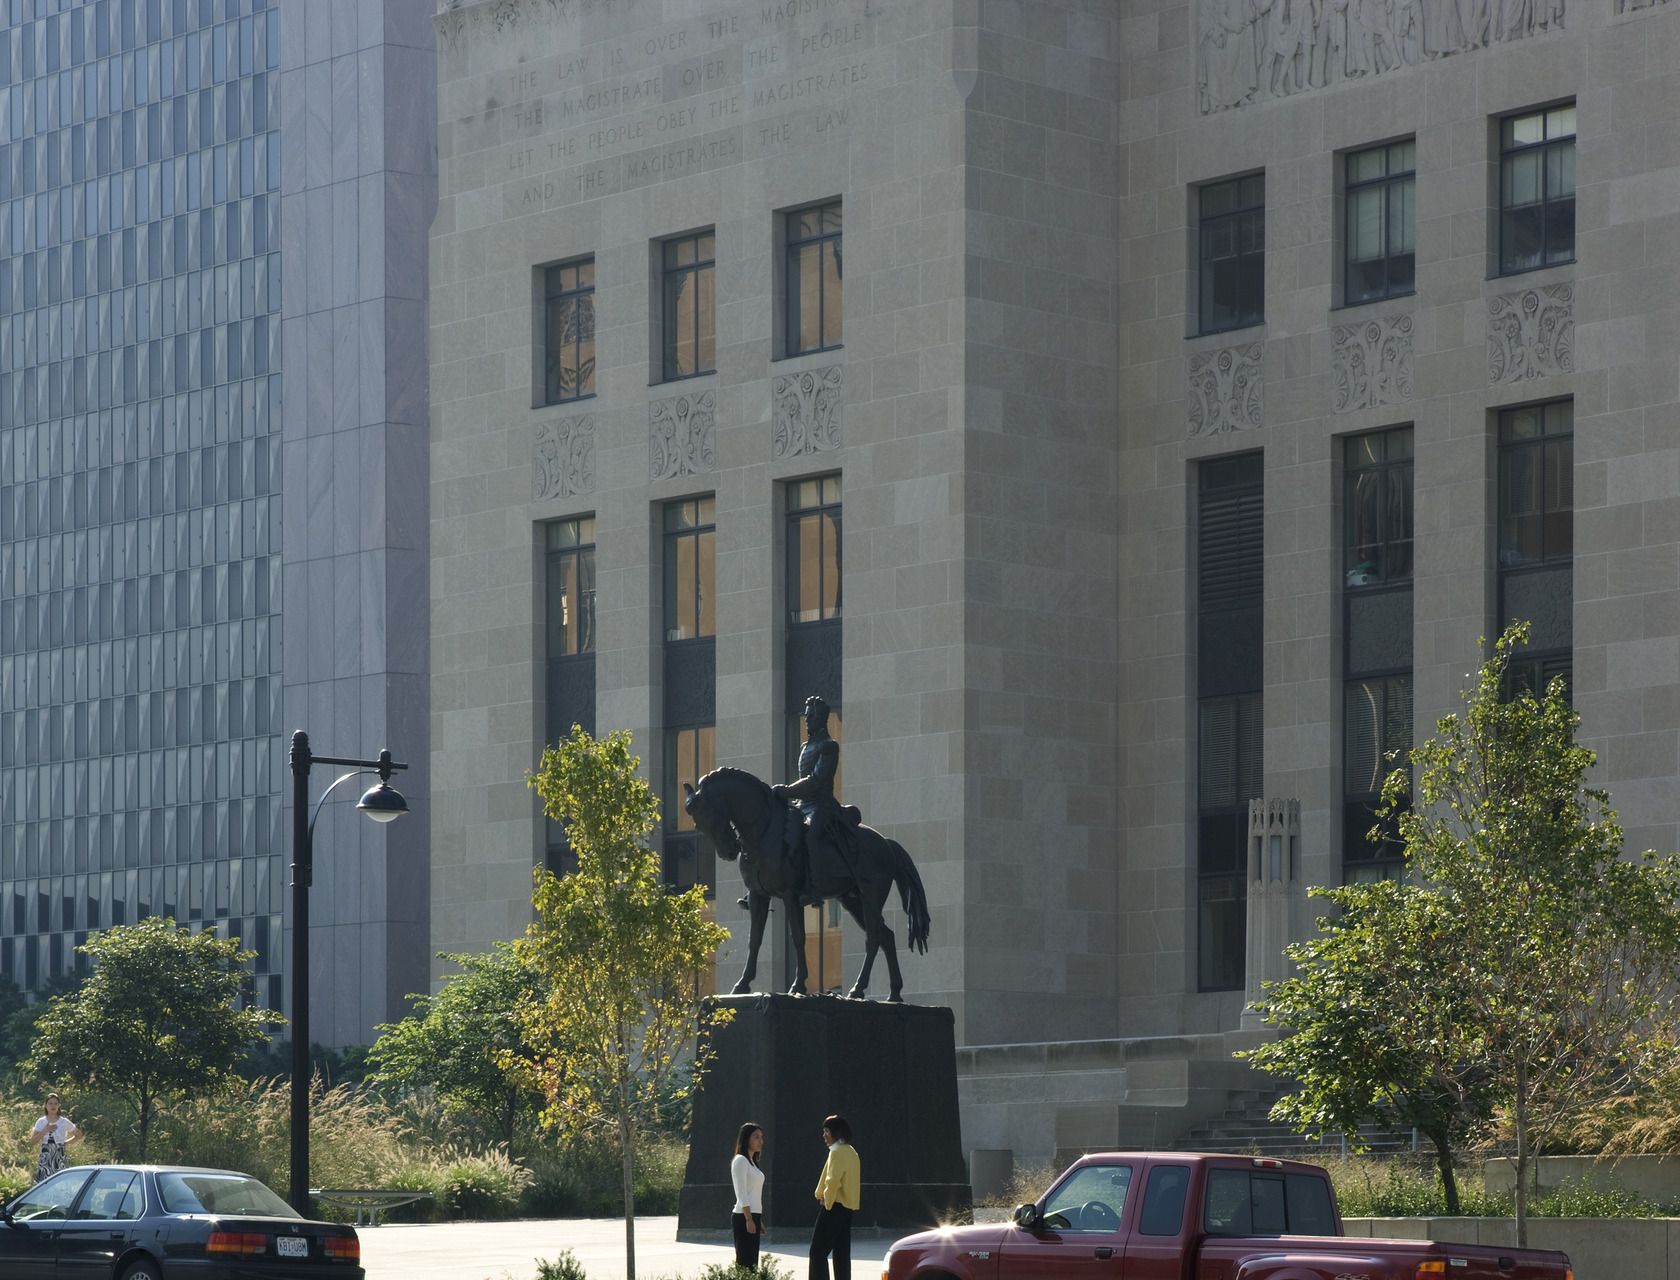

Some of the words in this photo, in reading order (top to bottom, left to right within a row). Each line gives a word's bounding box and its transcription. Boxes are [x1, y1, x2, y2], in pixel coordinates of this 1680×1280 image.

[508, 71, 538, 93] THE
[558, 56, 589, 80] LAW
[610, 48, 623, 66] IS
[645, 31, 687, 56] OVER
[708, 15, 738, 39] THE
[514, 108, 543, 130] THE
[562, 77, 661, 118] MAGISTRATE
[682, 59, 727, 86] OVER
[747, 45, 778, 68] THE
[801, 23, 862, 55] PEOPLE
[509, 149, 534, 169] LET
[547, 138, 576, 160] THE
[588, 121, 644, 150] PEOPLE
[656, 106, 696, 132] OBEY
[708, 96, 739, 119] THE
[752, 63, 869, 108] MAGISTRATES
[522, 183, 555, 206] AND
[576, 169, 605, 191] THE
[627, 137, 737, 180] MAGISTRATES
[759, 124, 791, 146] THE
[816, 107, 851, 133] LAW
